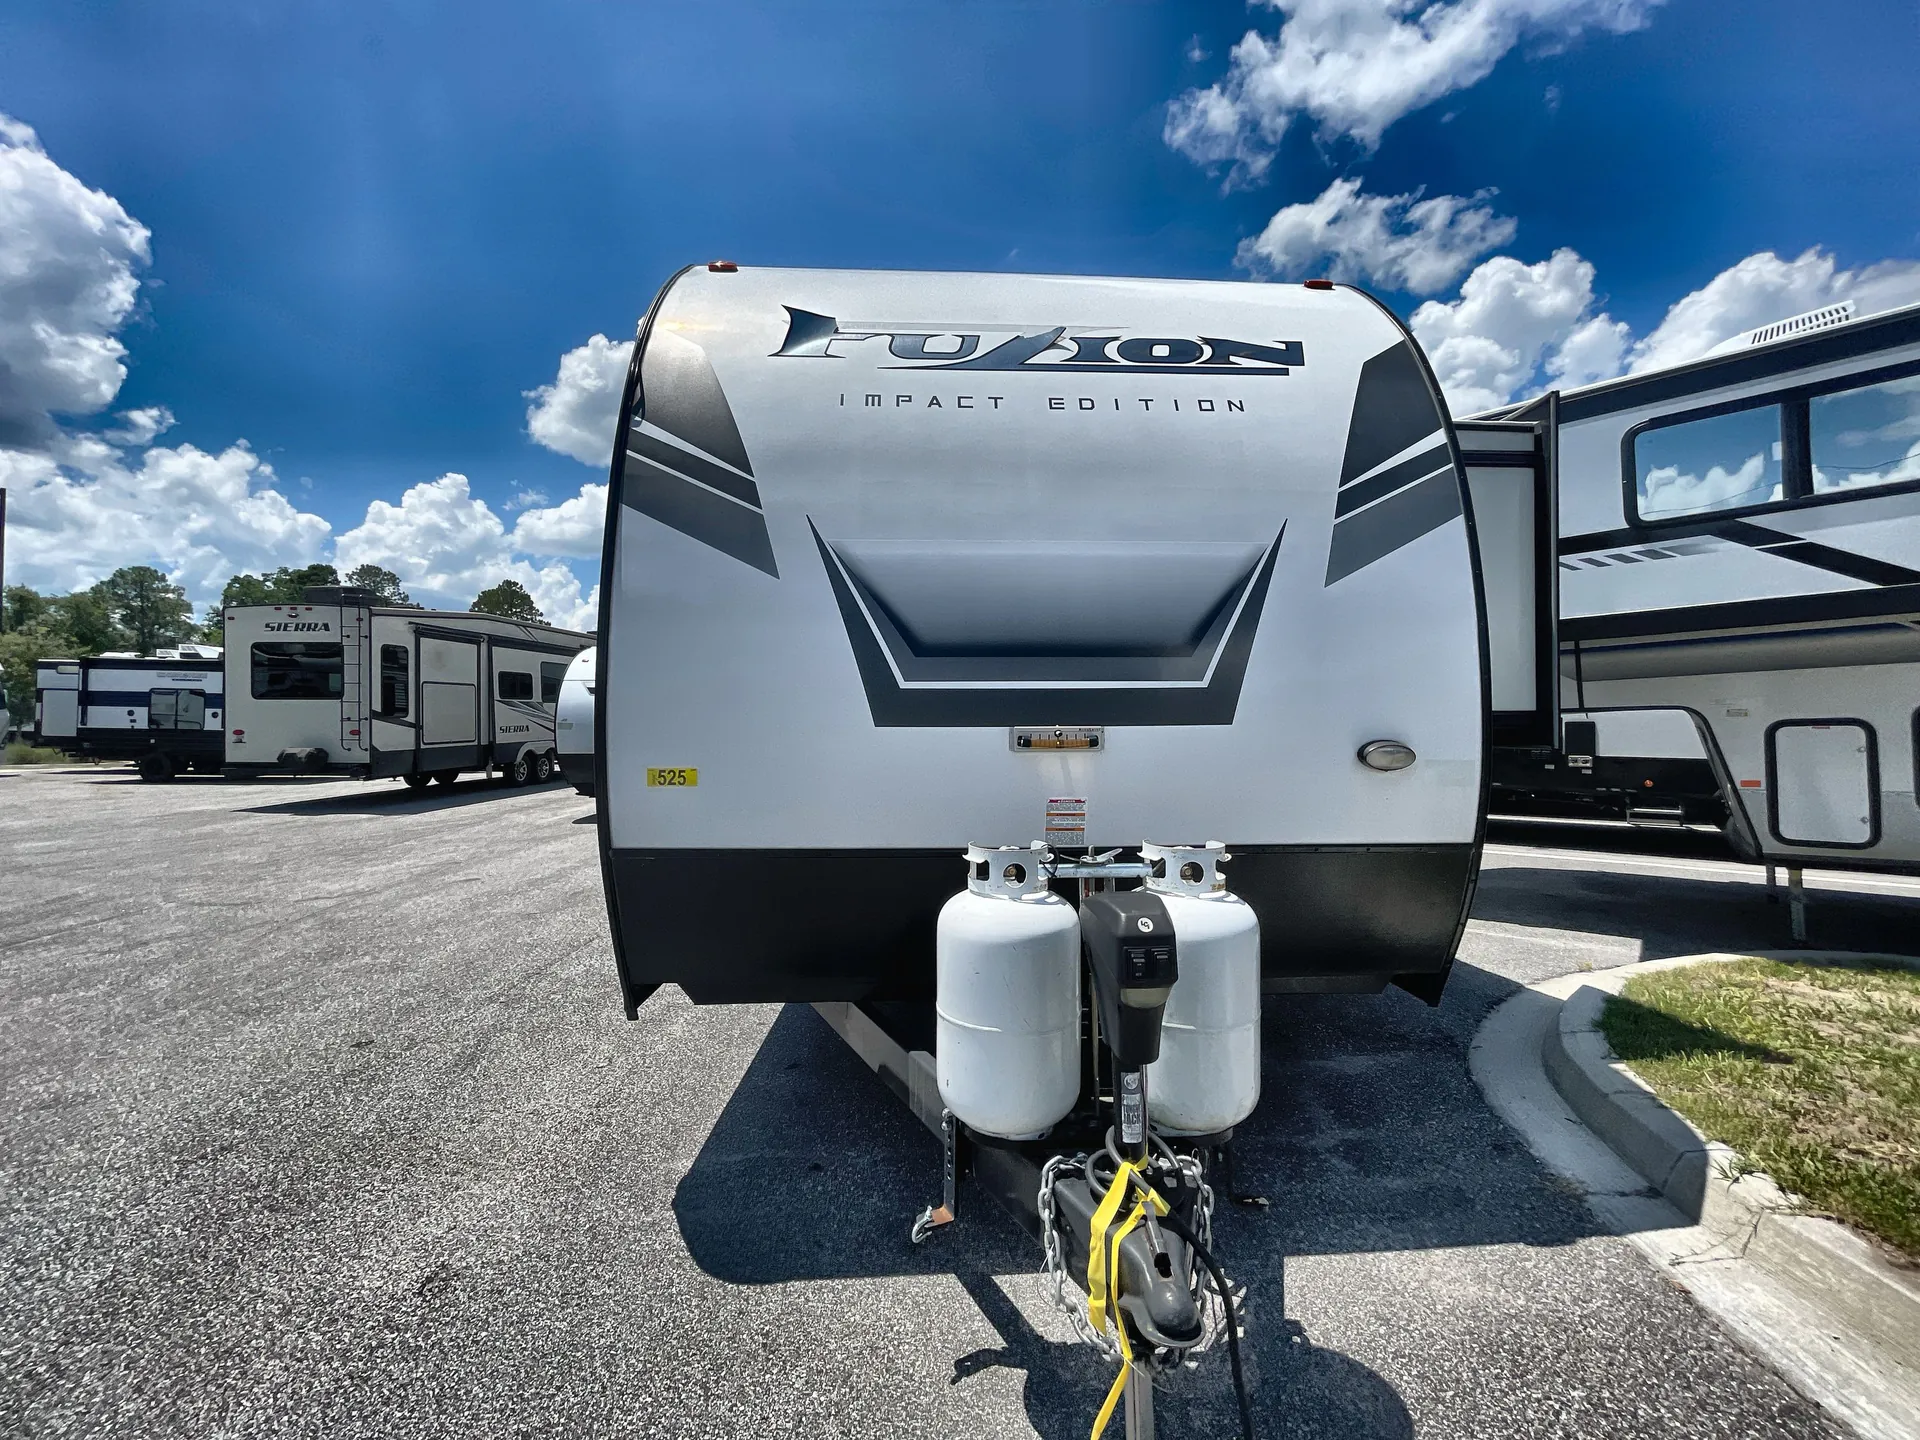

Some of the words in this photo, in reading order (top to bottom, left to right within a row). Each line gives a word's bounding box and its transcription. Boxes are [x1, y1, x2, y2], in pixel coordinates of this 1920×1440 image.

[768, 304, 1305, 376] FUZION
[840, 393, 1004, 410] IMPACT
[1049, 397, 1246, 412] EDITION
[264, 622, 330, 632] SIERRA
[500, 725, 530, 733] SIERRA
[658, 769, 687, 785] 525
